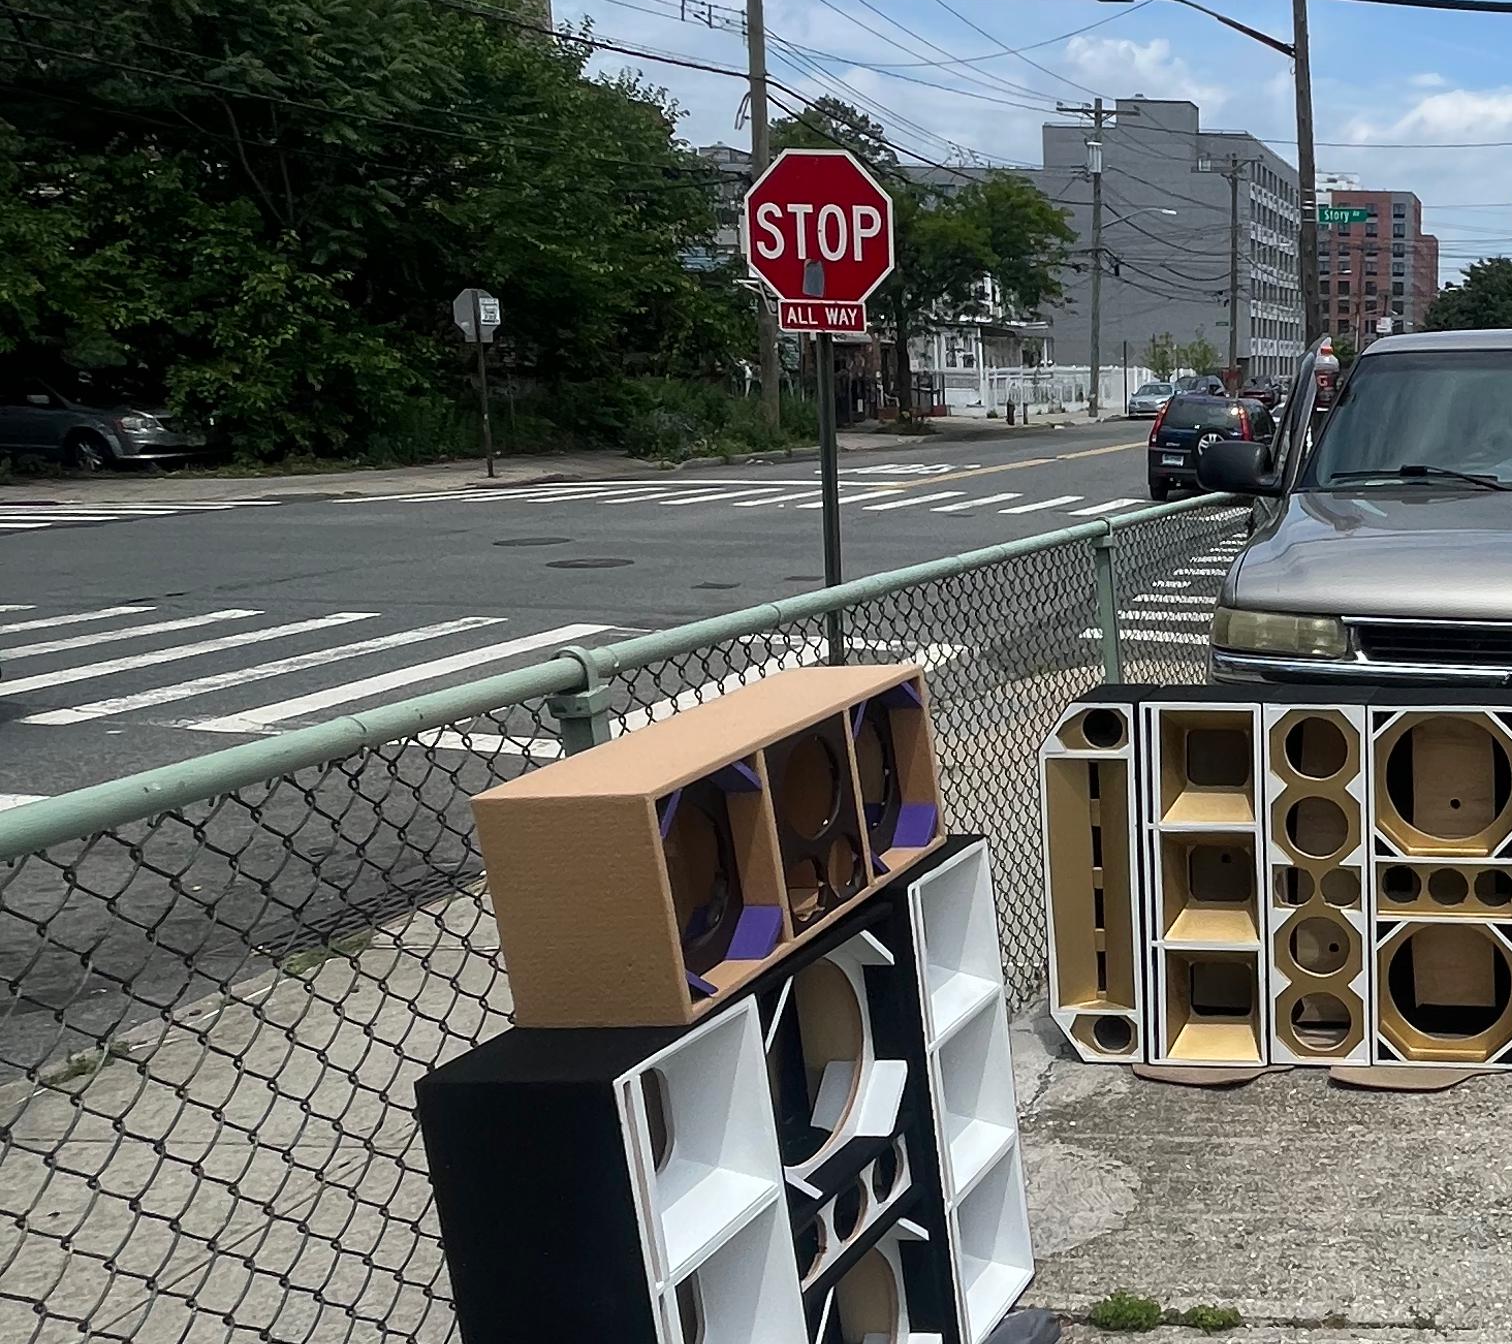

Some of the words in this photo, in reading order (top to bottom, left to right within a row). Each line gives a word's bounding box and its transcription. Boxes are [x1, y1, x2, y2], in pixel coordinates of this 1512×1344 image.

[1324, 209, 1350, 224] Story
[756, 202, 882, 262] STOP
[787, 306, 818, 325] ALL
[825, 307, 857, 326] WAY
